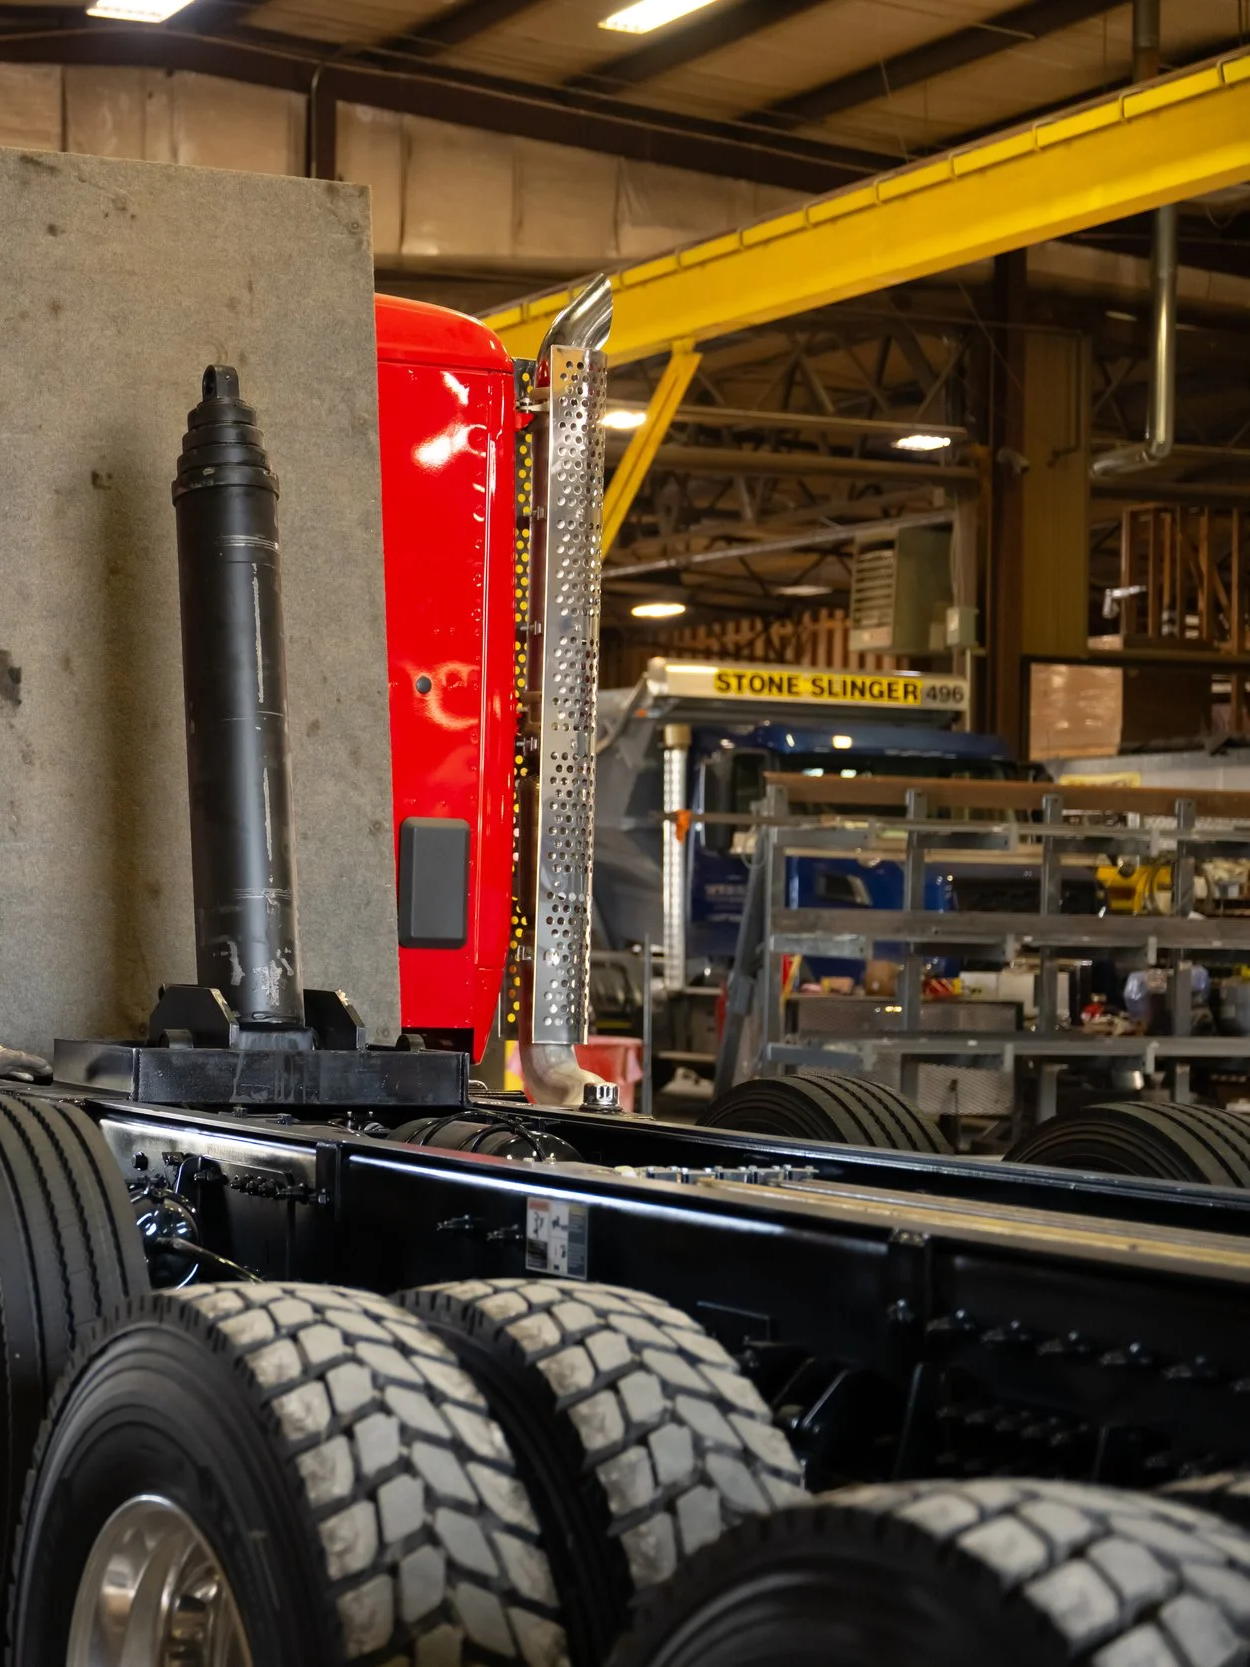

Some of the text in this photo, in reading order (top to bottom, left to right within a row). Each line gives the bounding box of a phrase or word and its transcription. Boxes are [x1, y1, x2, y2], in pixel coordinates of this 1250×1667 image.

[717, 672, 964, 704] STONE SLINGER 496
